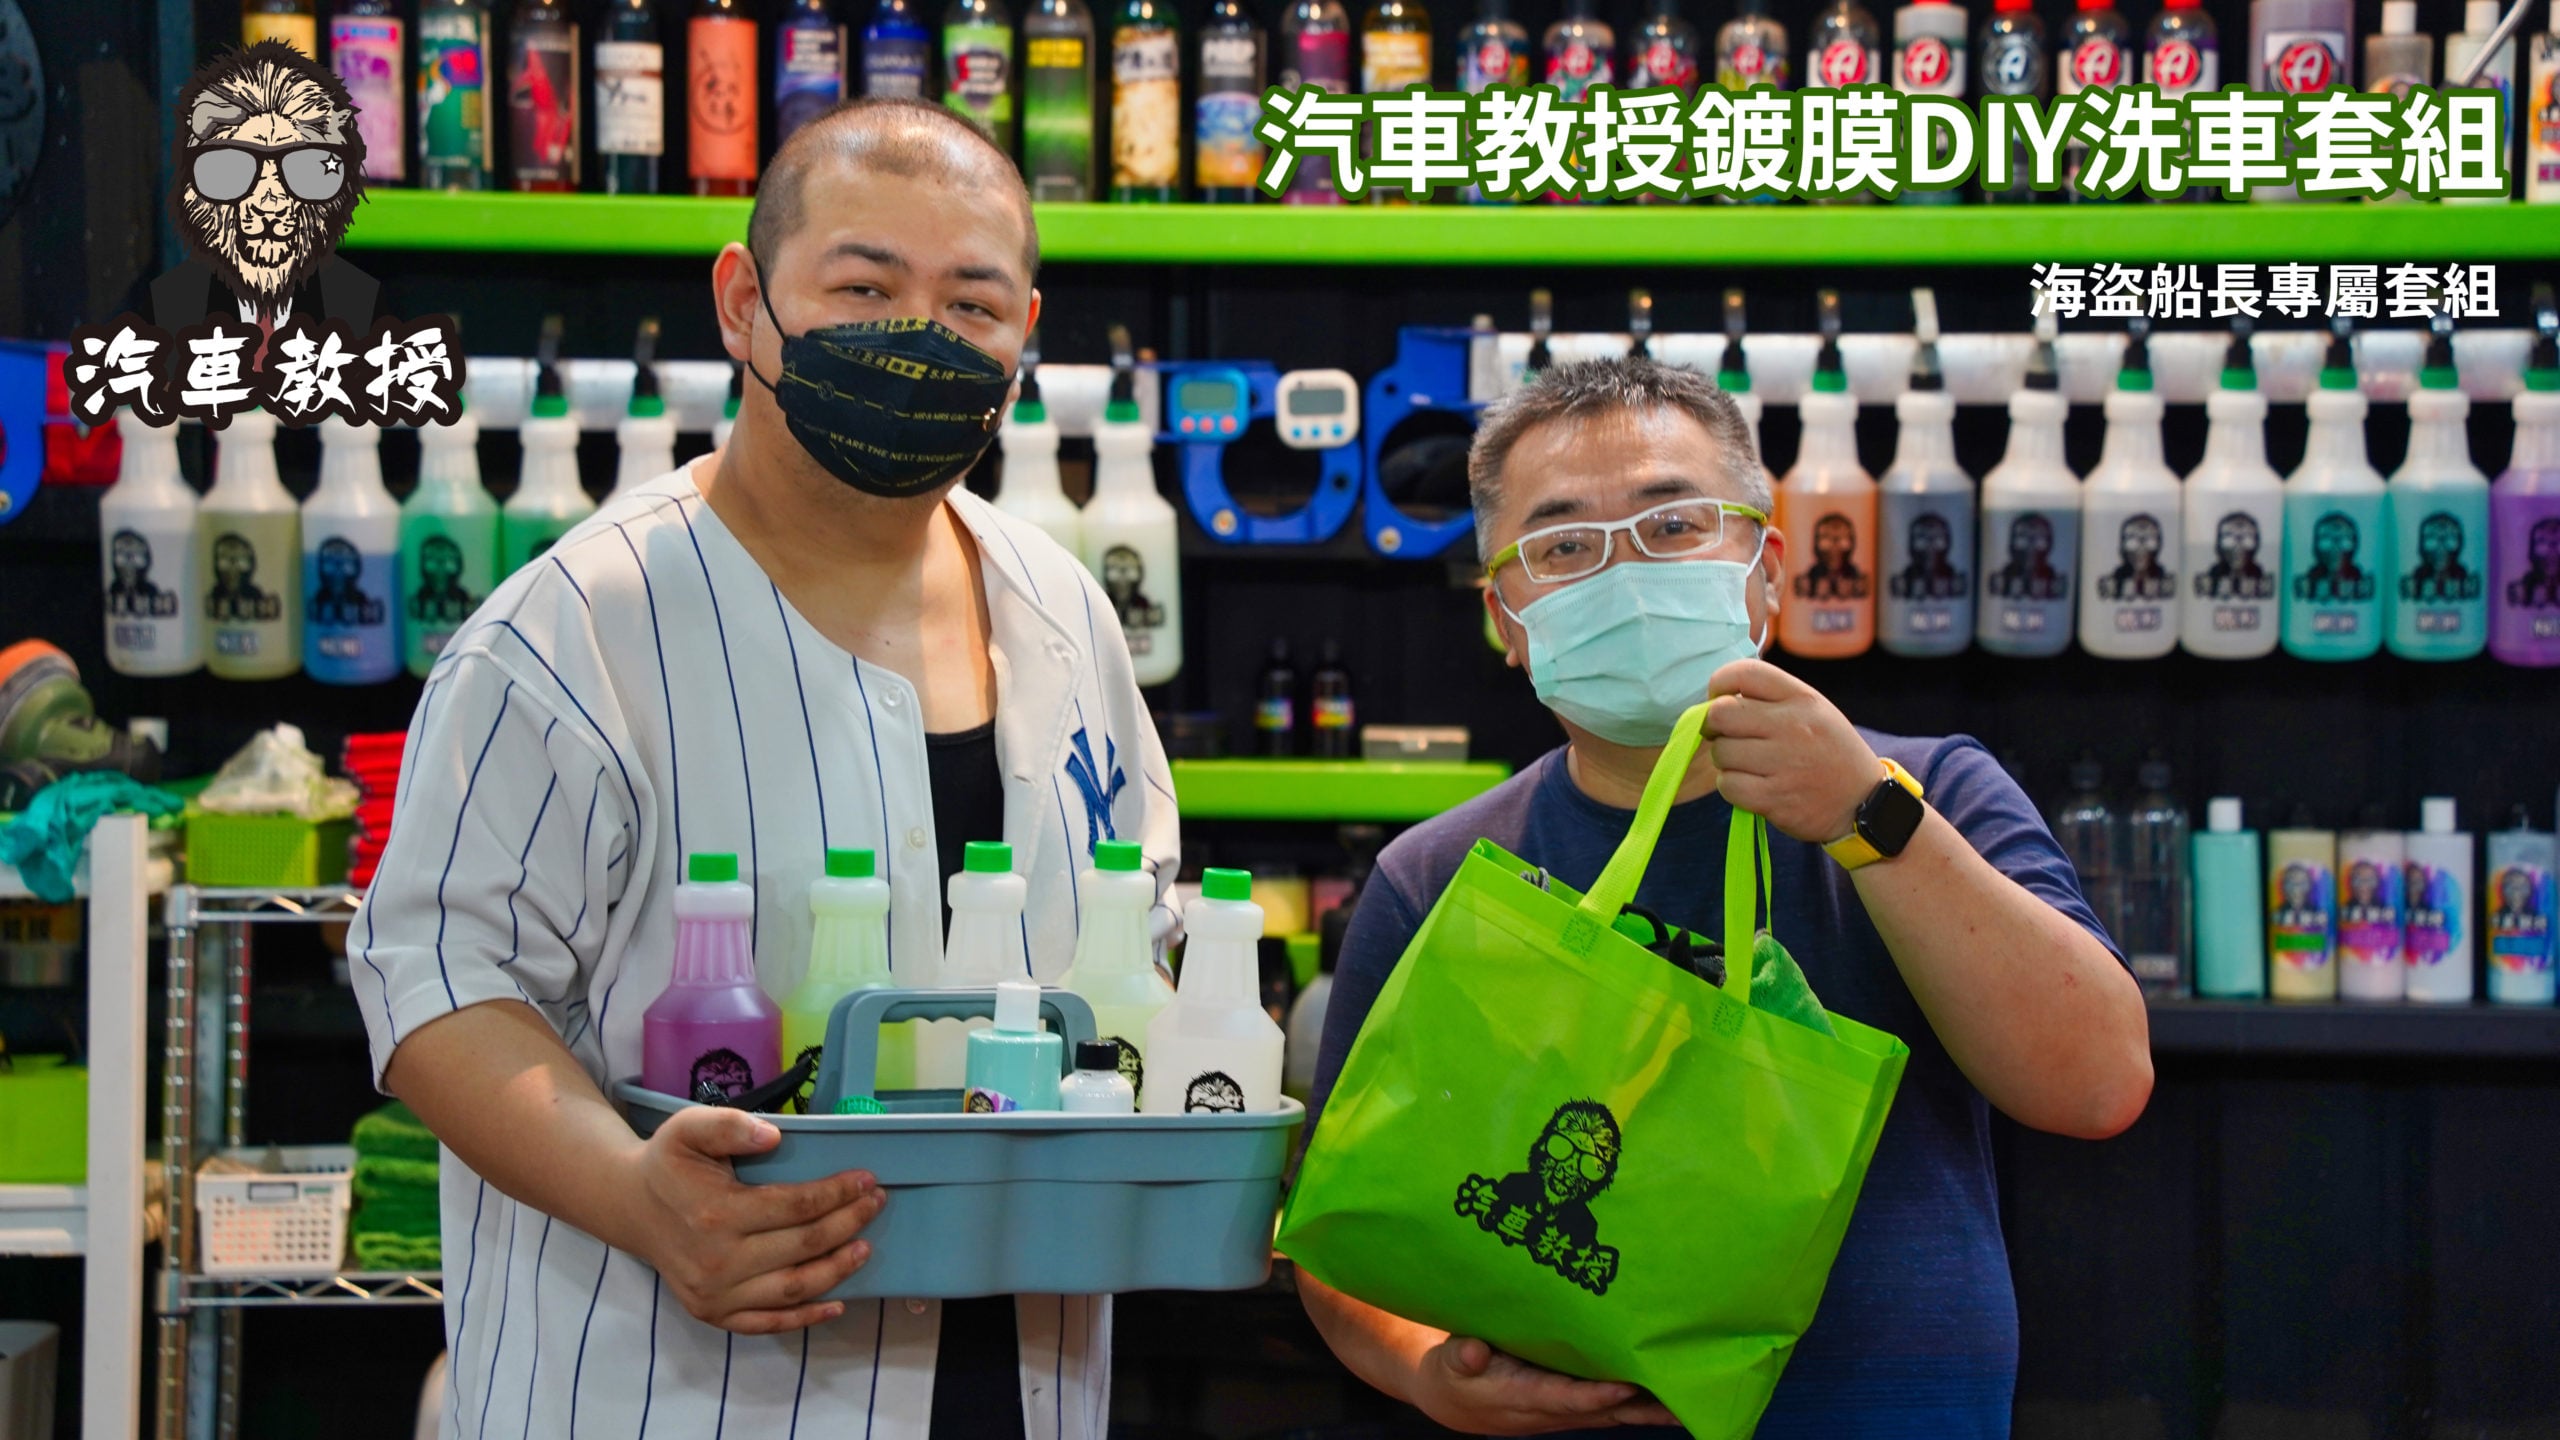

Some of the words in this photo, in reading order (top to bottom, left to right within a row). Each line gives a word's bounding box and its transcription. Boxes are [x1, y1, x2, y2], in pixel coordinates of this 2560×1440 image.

[830, 431, 844, 443] WE
[845, 438, 866, 451] ARE
[867, 444, 889, 458] THE
[890, 450, 915, 462] NEXT
